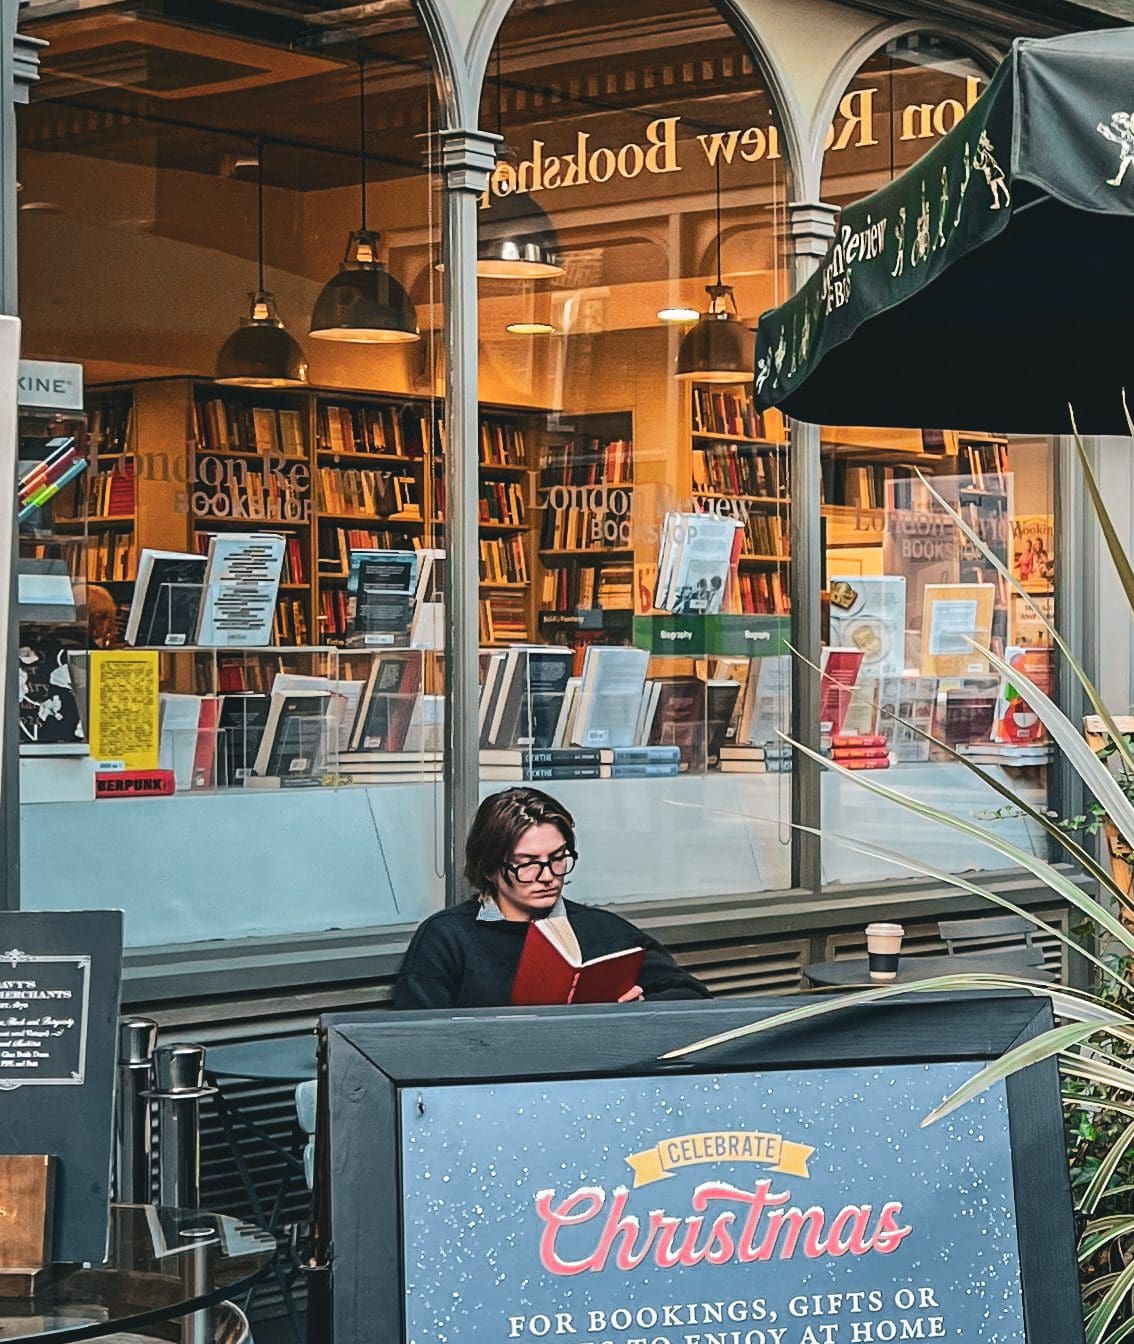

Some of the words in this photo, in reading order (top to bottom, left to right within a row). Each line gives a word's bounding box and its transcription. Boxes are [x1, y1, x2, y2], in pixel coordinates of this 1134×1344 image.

[591, 519, 698, 546] BOOKSOP
[660, 629, 693, 640] Biography
[666, 1134, 778, 1164] CELEBRATE
[535, 1178, 913, 1276] Christmas
[508, 1312, 577, 1339] FOR
[588, 1298, 778, 1333] BOOKINGS,
[788, 1290, 883, 1317] GIFTS
[894, 1286, 939, 1310] OR
[850, 1316, 947, 1344] HOME
